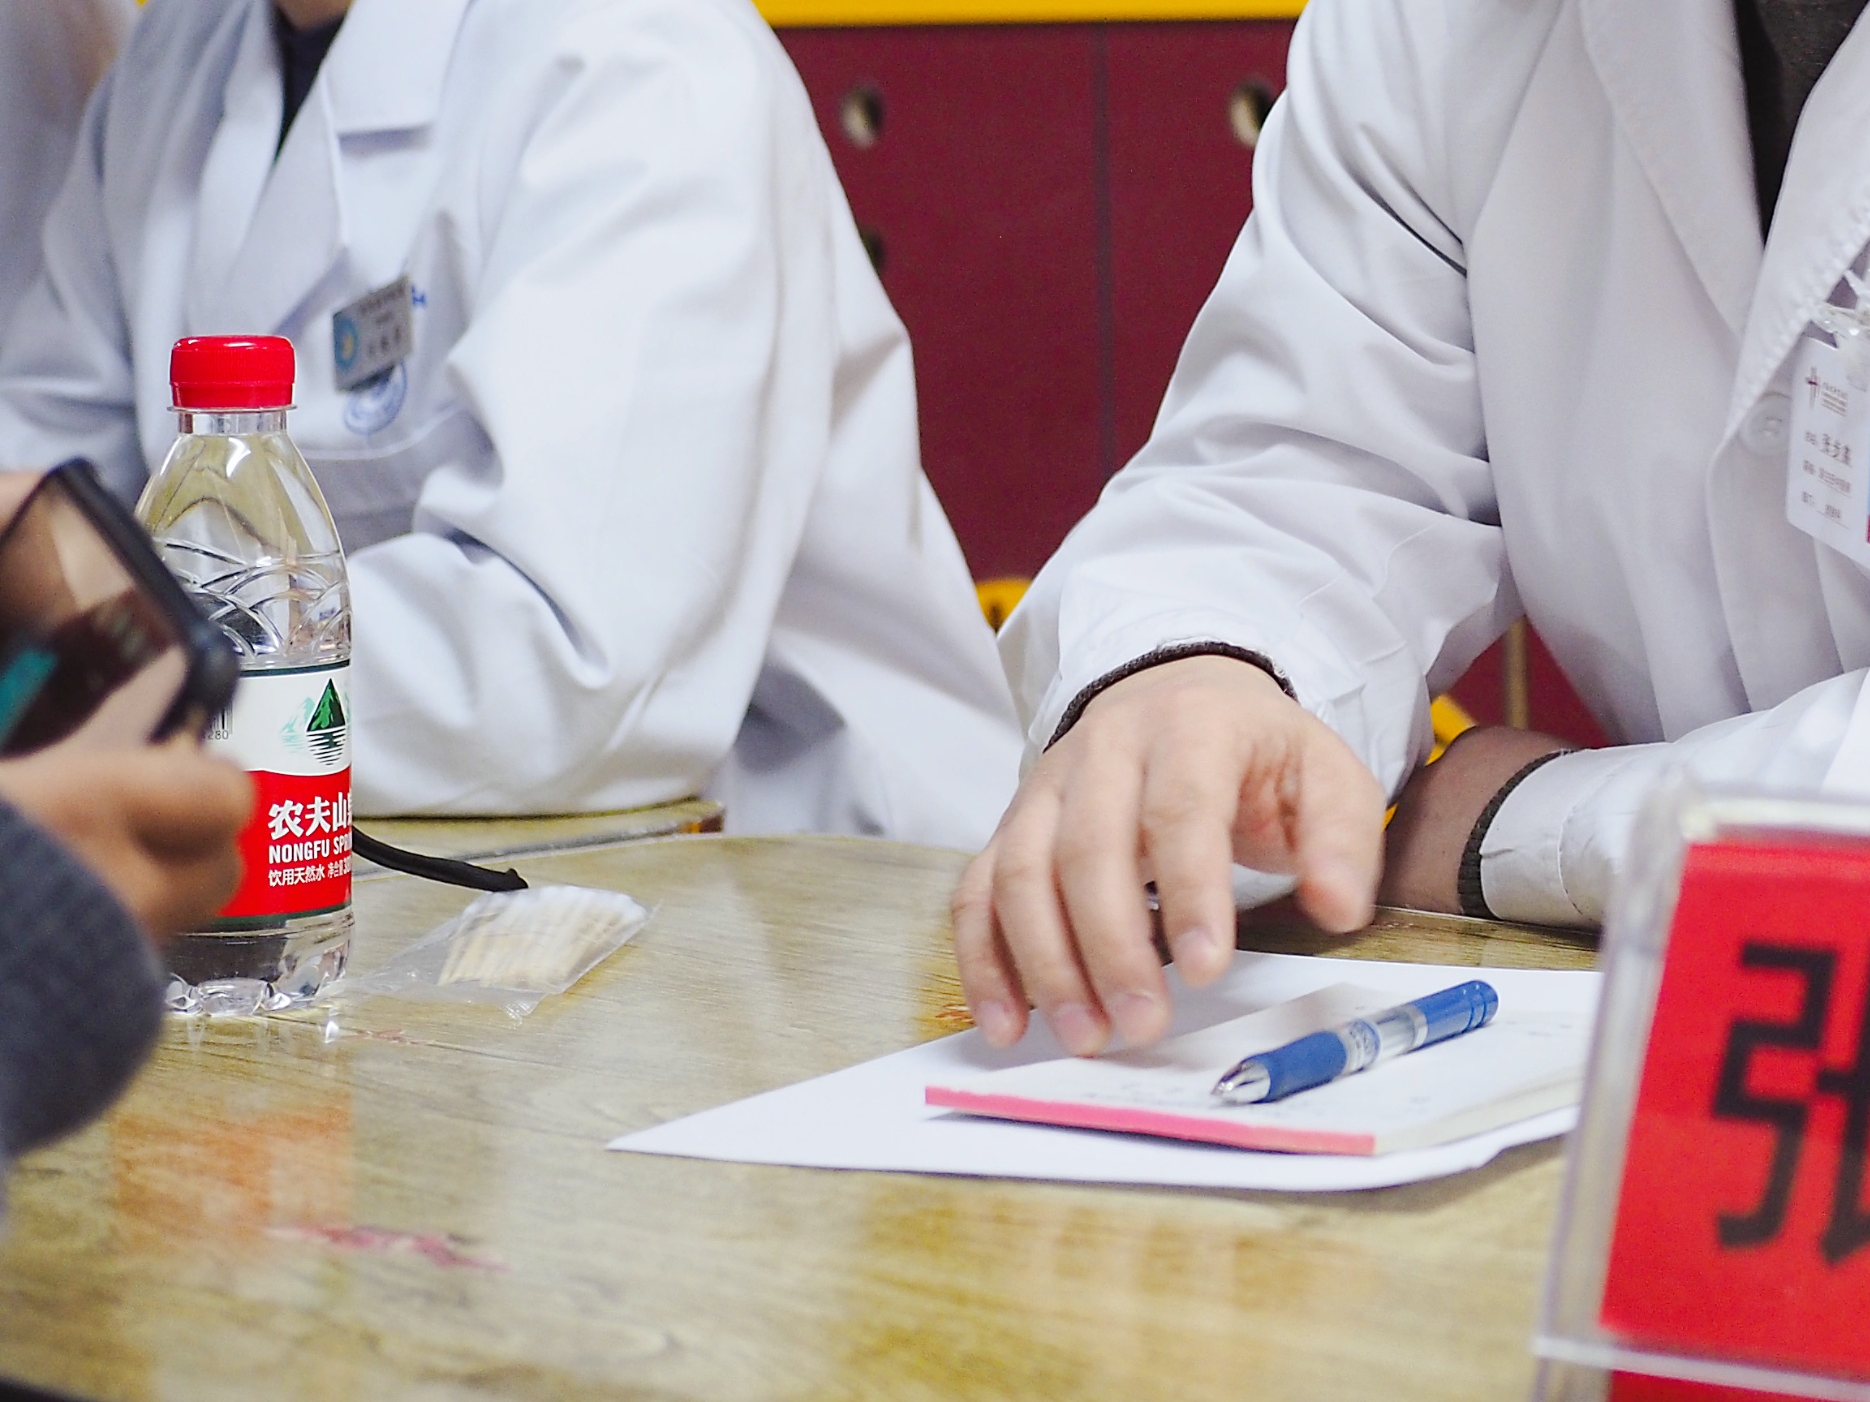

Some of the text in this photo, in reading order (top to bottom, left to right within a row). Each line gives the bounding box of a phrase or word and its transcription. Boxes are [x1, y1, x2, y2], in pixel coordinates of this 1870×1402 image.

[268, 838, 330, 864] NONGFU
[268, 863, 326, 887] 饮用天然水
